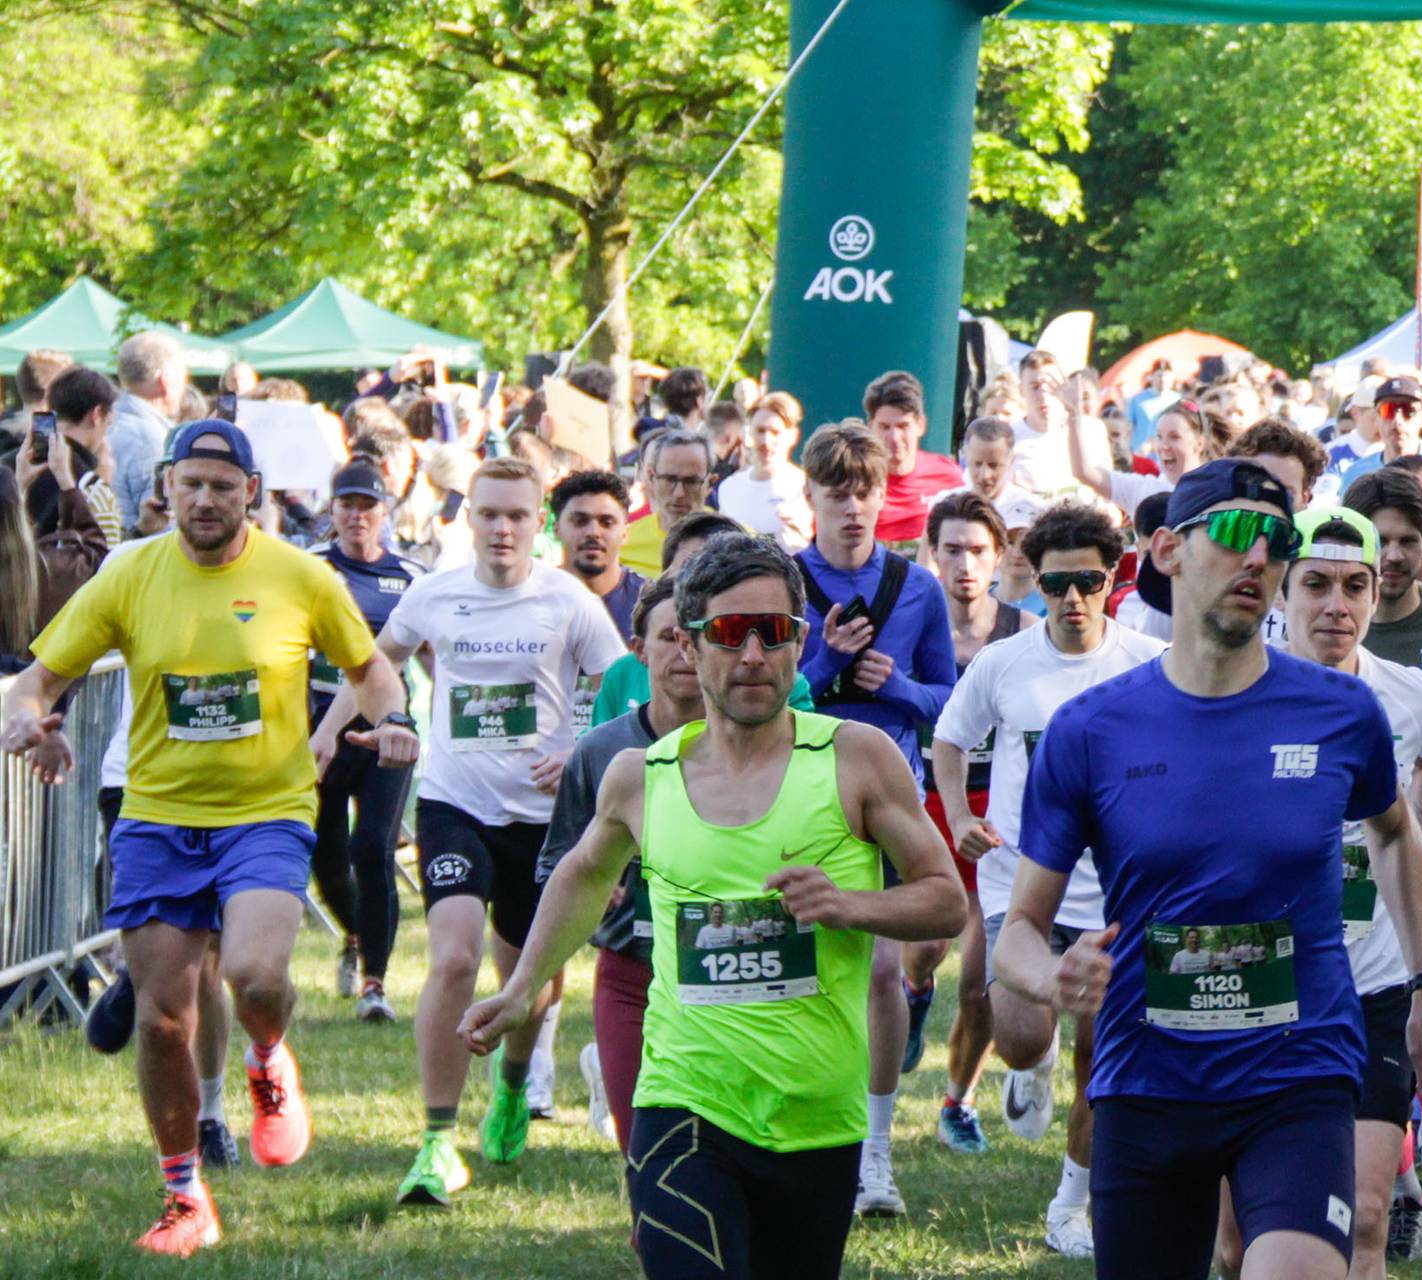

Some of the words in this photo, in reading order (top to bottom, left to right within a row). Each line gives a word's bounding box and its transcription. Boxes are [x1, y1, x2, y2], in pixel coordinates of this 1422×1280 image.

[803, 266, 894, 304] AOK
[454, 638, 548, 654] mosecker
[195, 704, 227, 717] 1132
[188, 715, 237, 728] PHILIPP
[478, 715, 504, 727] 946
[477, 727, 506, 738] MIKA
[701, 950, 783, 982] 1255
[1194, 974, 1243, 992] 1120
[1189, 992, 1250, 1009] SIMON
